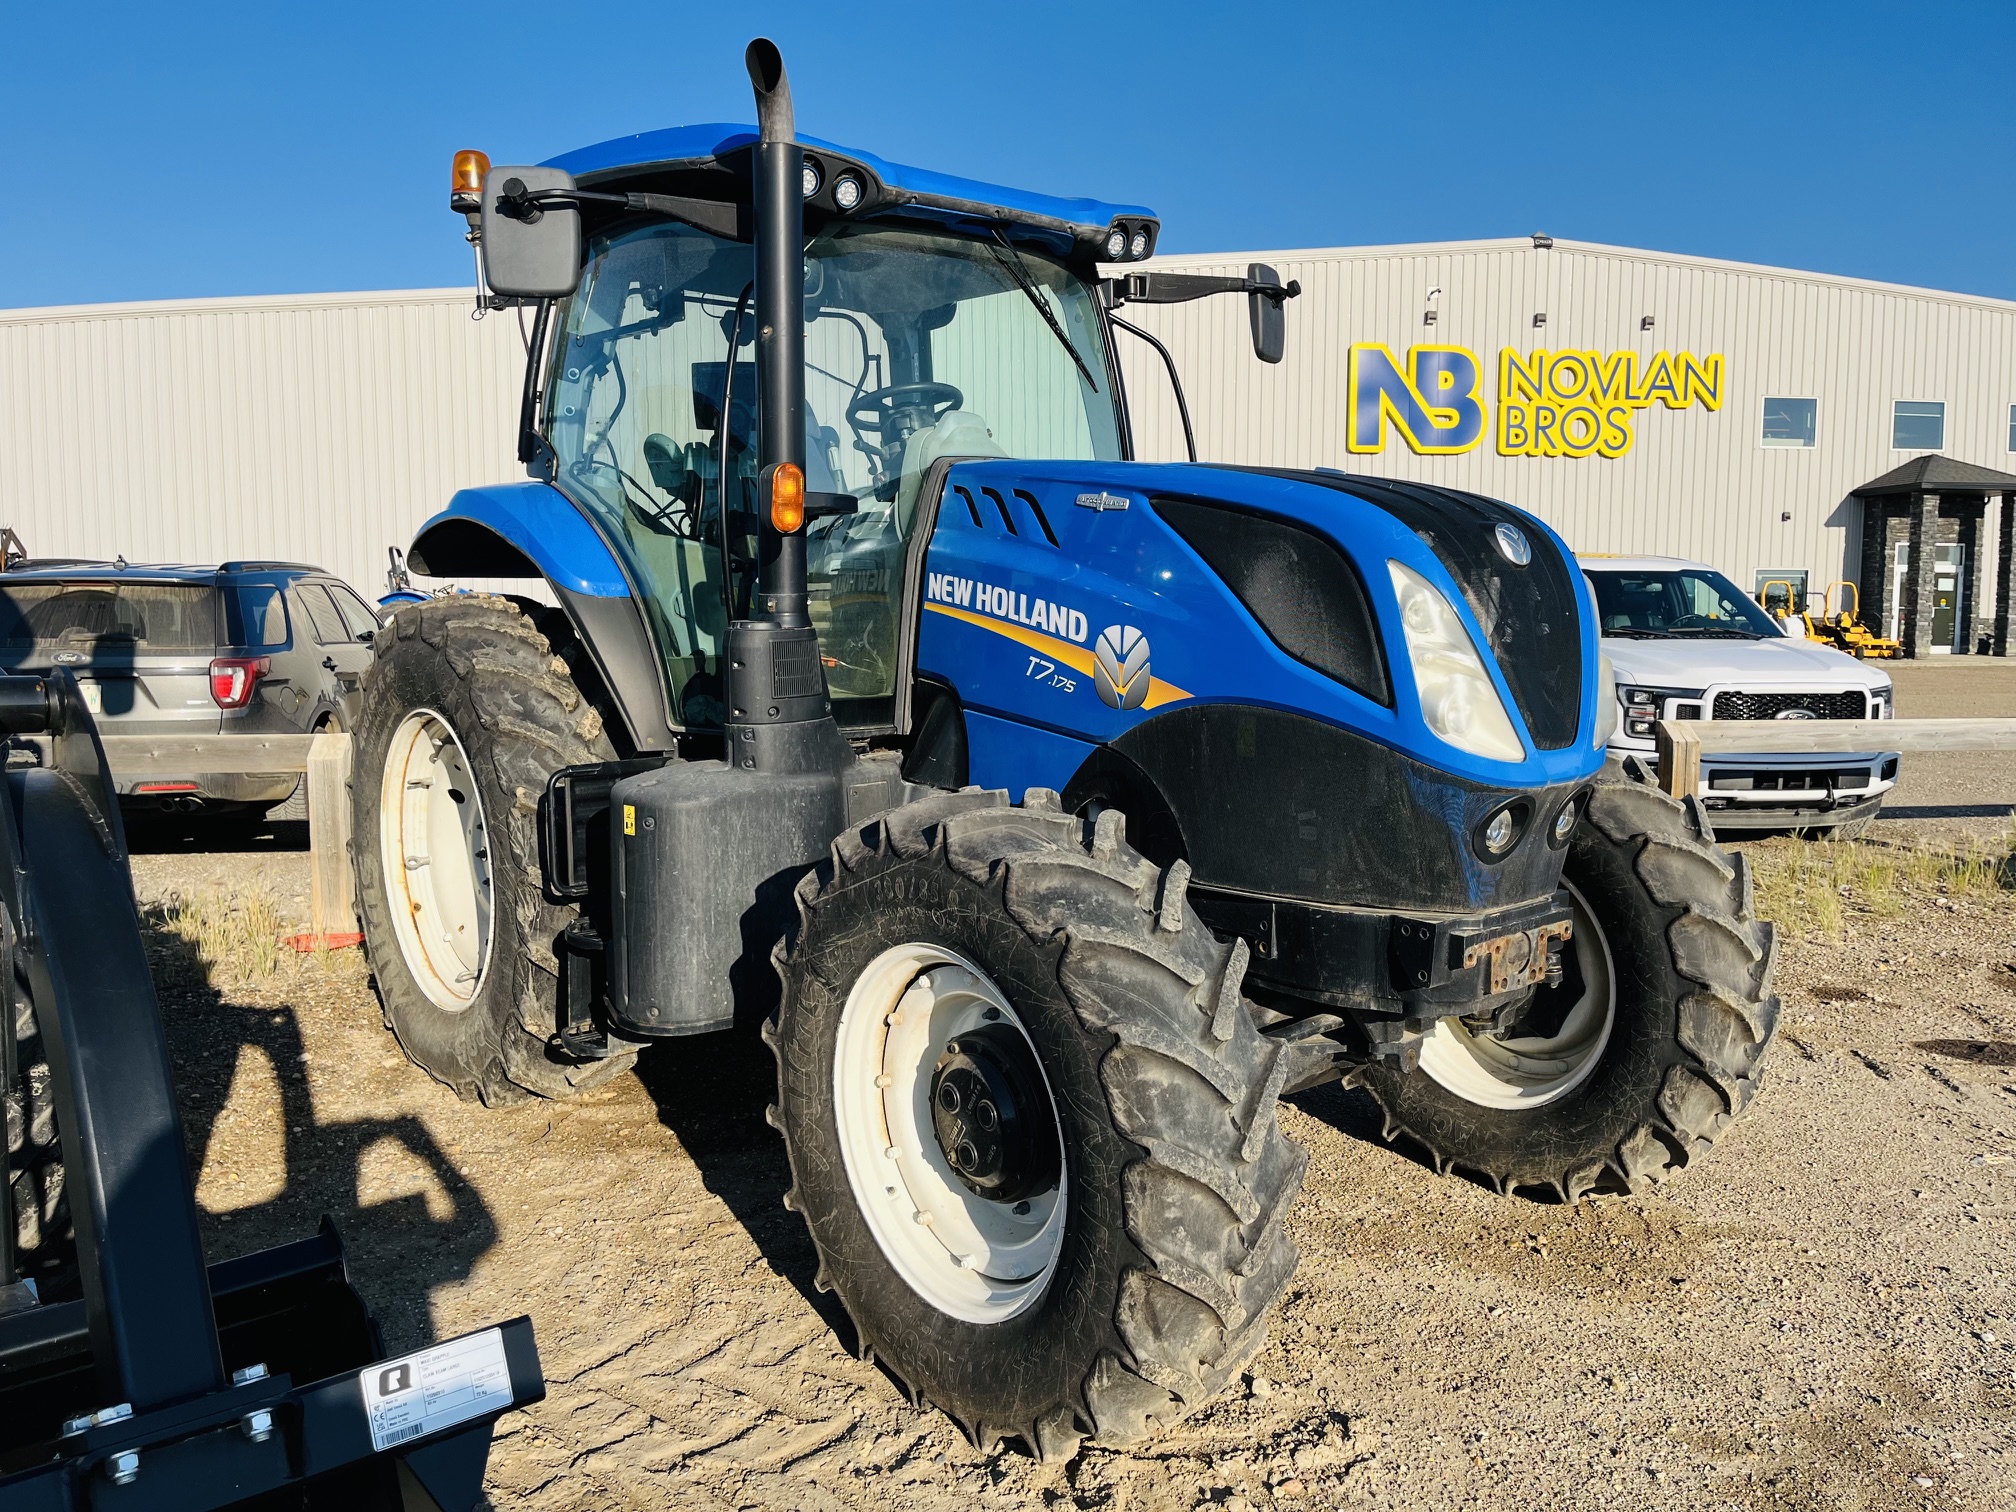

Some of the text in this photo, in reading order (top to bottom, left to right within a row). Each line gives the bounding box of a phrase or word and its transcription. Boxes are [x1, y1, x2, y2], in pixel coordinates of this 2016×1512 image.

[1351, 345, 1486, 450] NB
[1504, 347, 1721, 406] NOVLAN
[1503, 403, 1630, 454] BROS
[928, 572, 1089, 643] NEW HOLLAND
[57, 653, 78, 662] Ford
